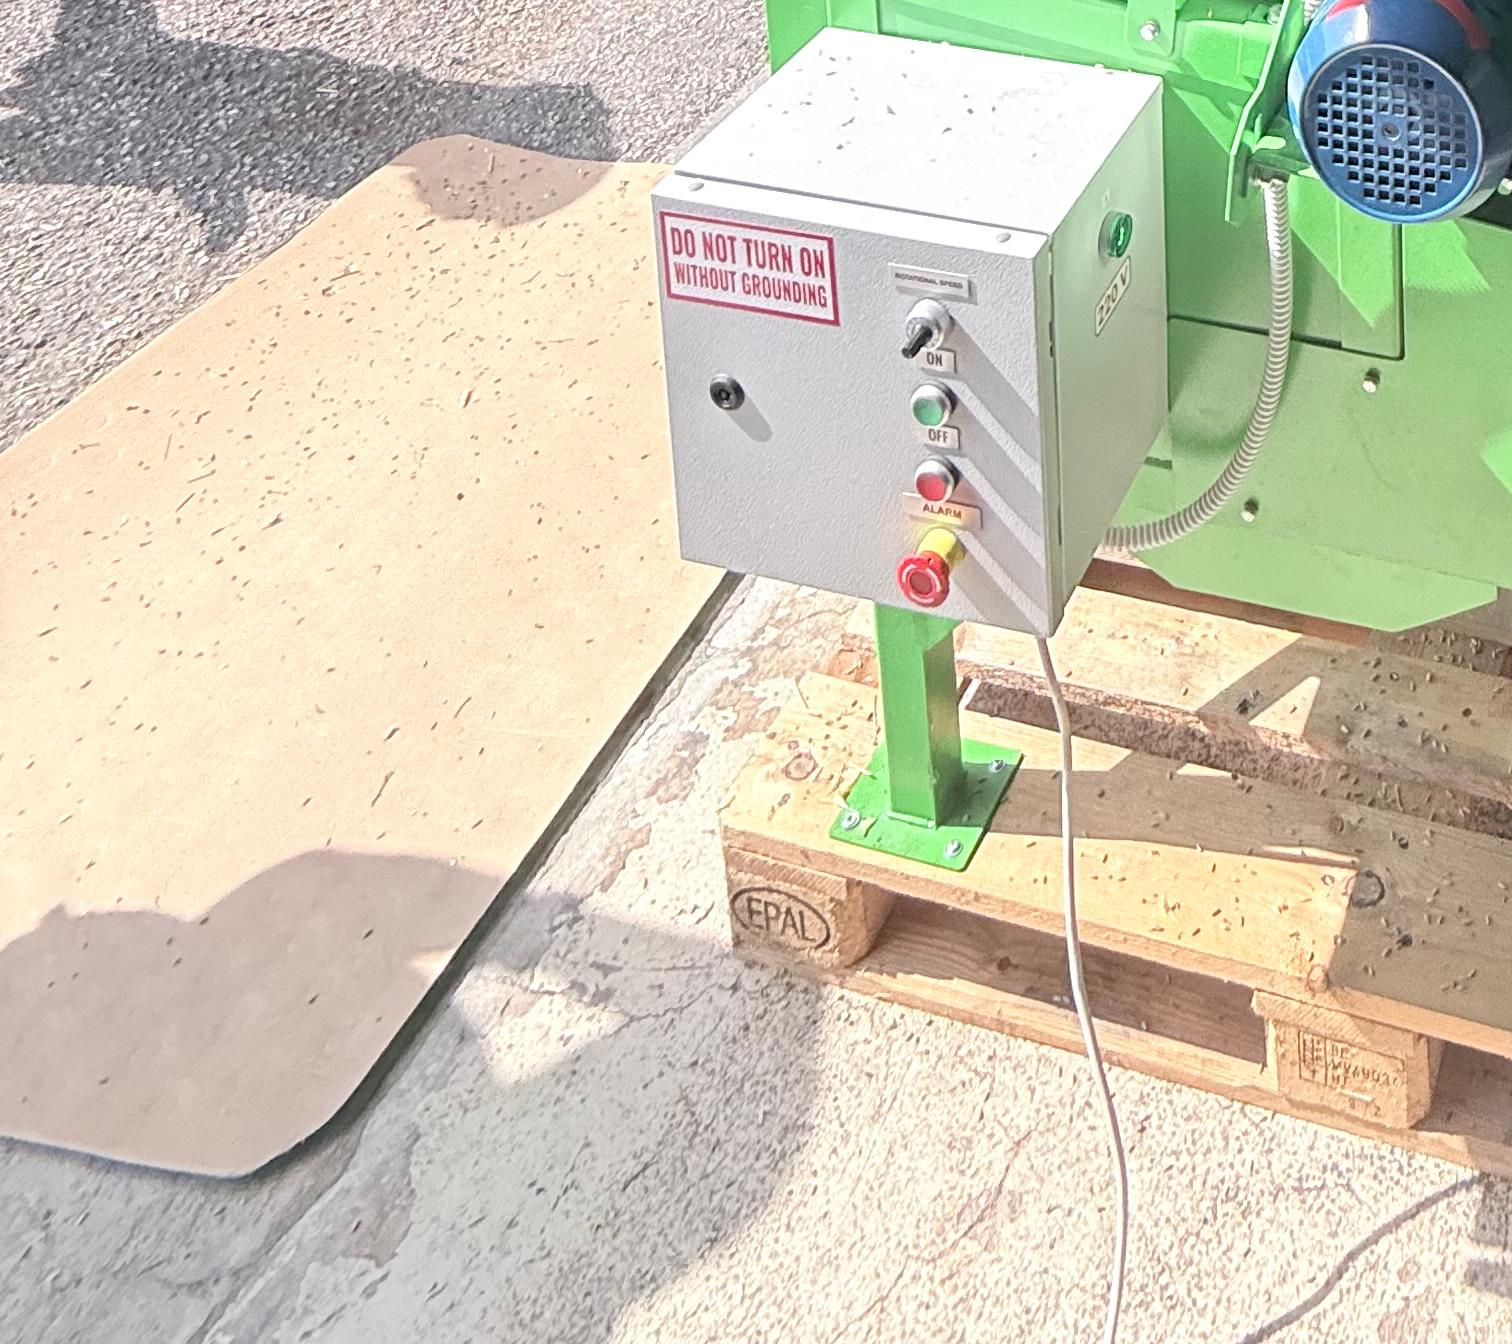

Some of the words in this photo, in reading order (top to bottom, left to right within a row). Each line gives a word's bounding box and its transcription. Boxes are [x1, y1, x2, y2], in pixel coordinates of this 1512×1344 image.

[670, 226, 696, 258] DO
[702, 231, 737, 265] NOT
[743, 238, 794, 274] TURN
[800, 247, 826, 279] ON
[674, 262, 737, 294] WITHOUT
[741, 272, 828, 308] GROUNDING
[1098, 283, 1118, 327] 220
[1120, 265, 1128, 286] V
[926, 351, 943, 367] ON
[928, 428, 948, 444] OFF
[923, 503, 962, 519] ALARM
[746, 895, 817, 944] EPAL
